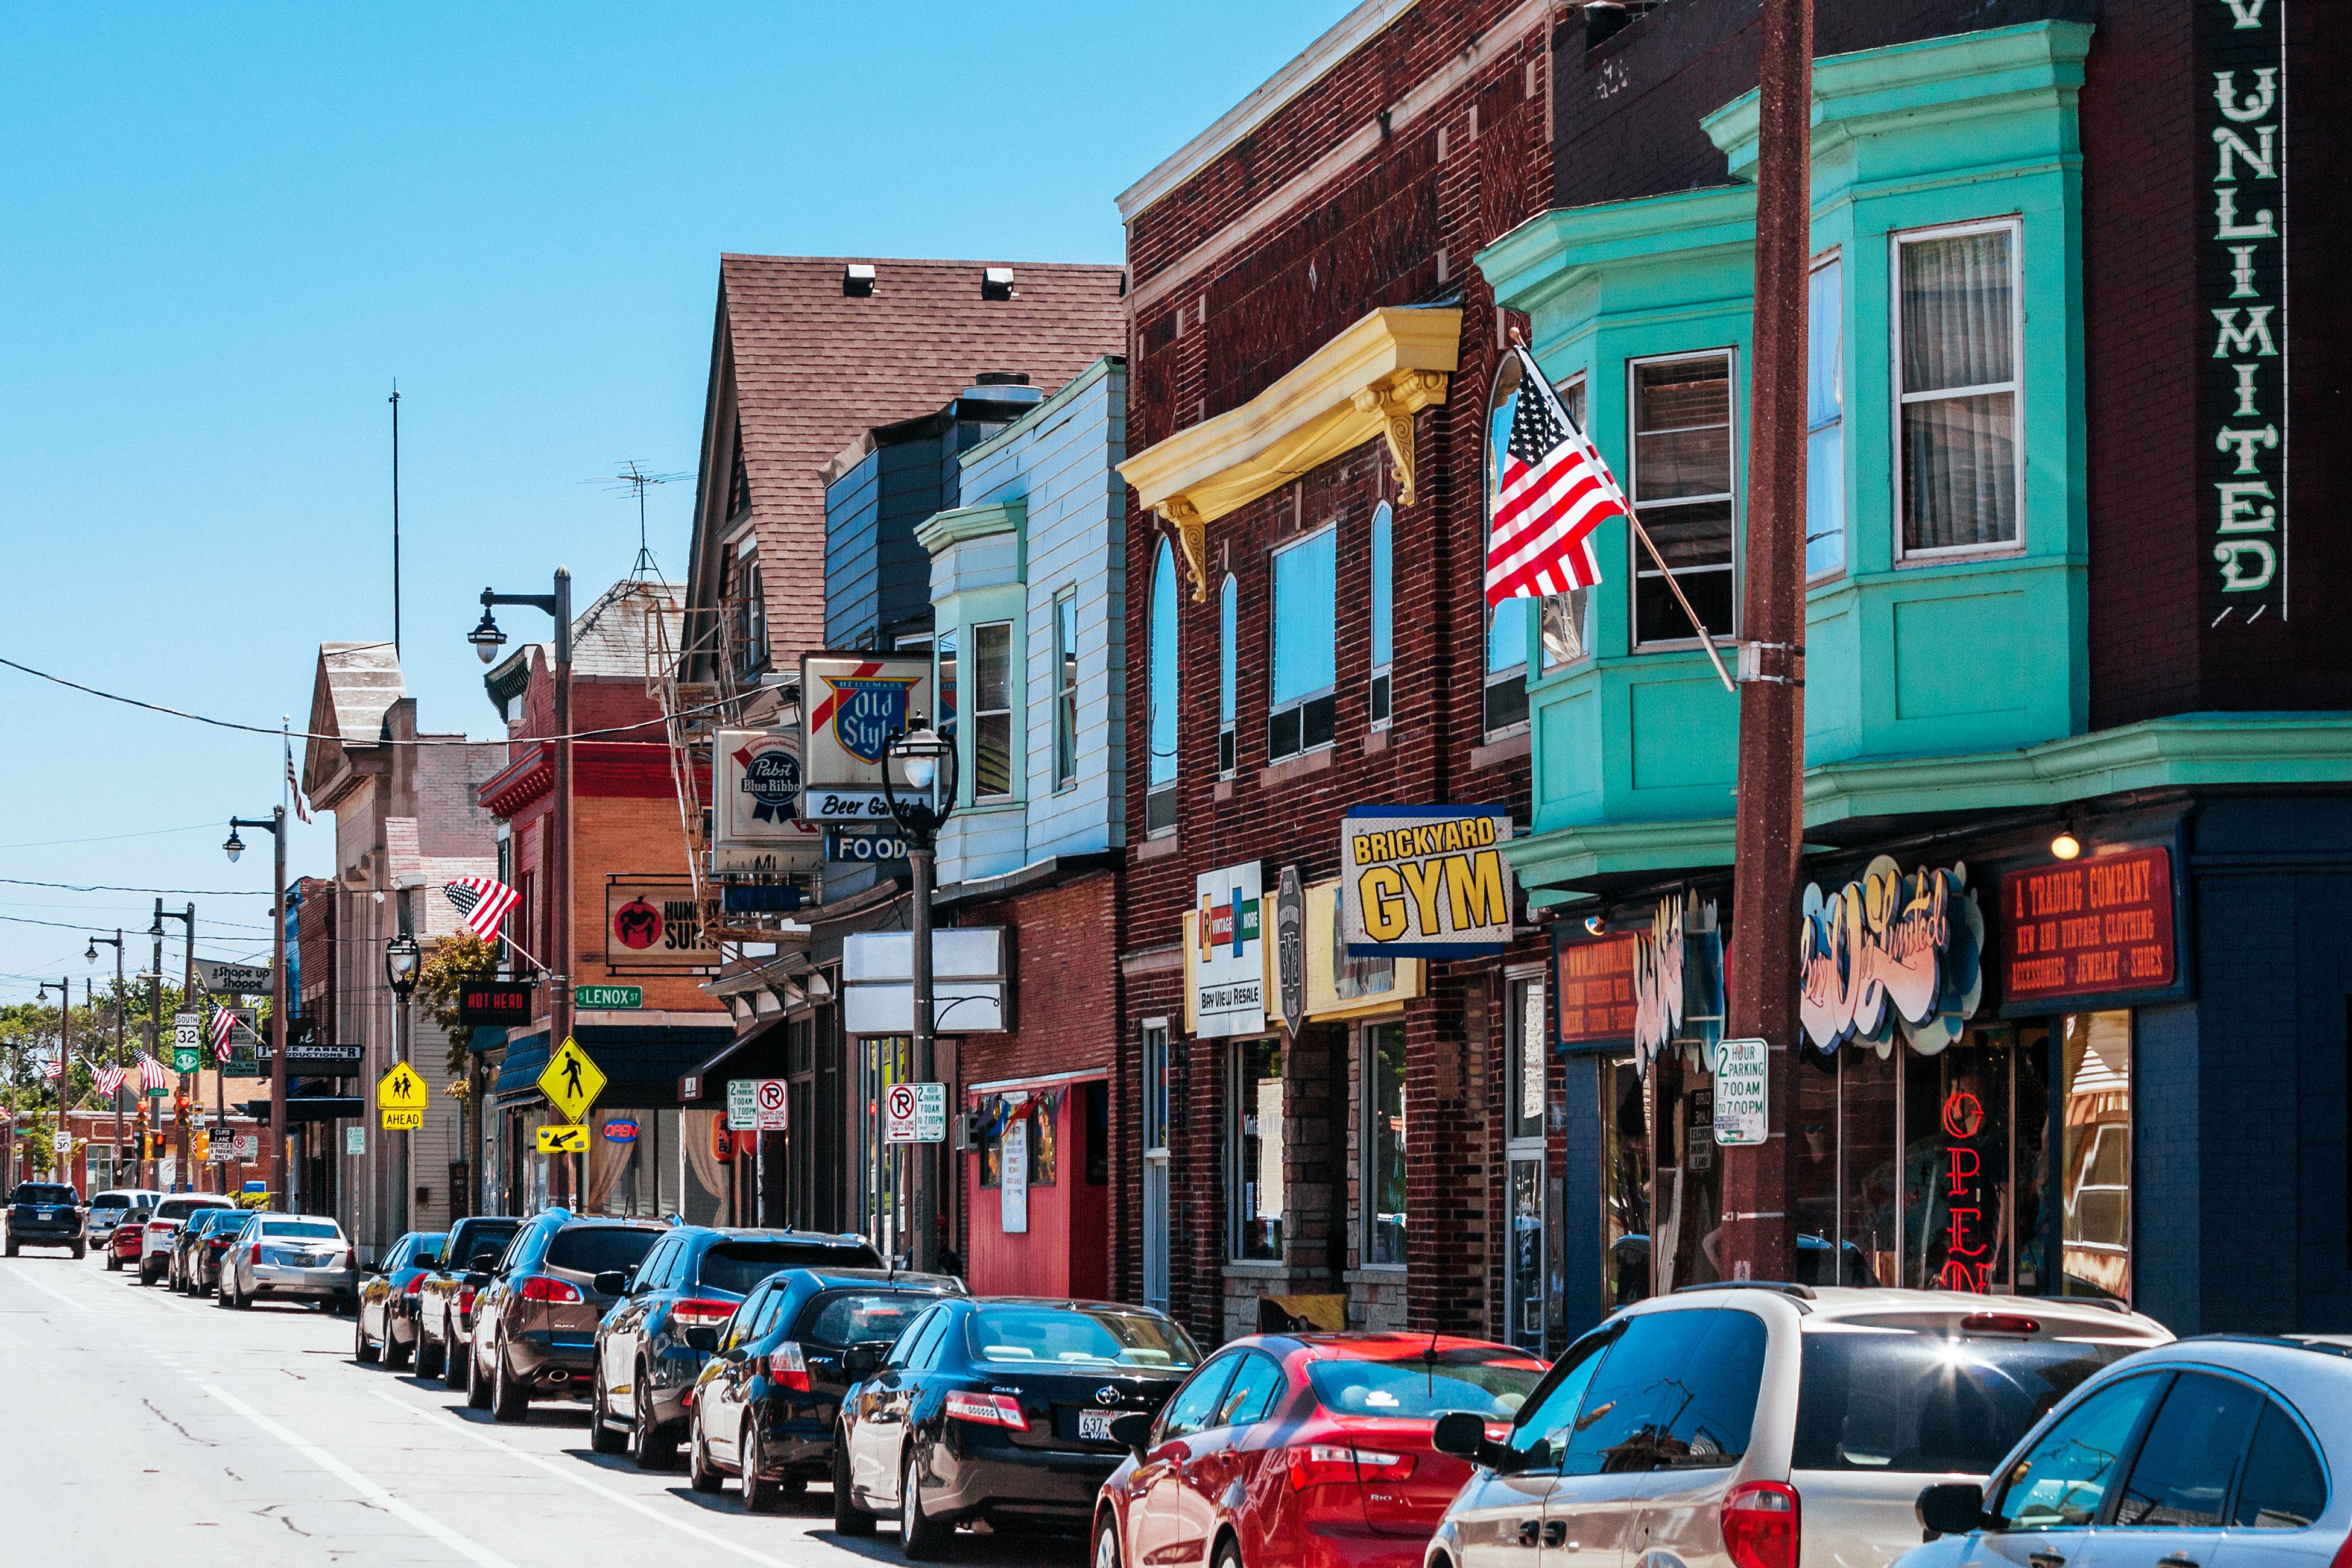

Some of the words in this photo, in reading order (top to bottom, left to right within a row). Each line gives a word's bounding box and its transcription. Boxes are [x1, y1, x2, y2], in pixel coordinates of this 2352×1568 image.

[2212, 68, 2278, 592] UNLIMITED
[855, 692, 892, 718] Old
[844, 716, 896, 754] Styl
[755, 759, 792, 776] Pabst
[744, 779, 767, 792] Blue
[769, 779, 800, 792] Ribbo
[821, 795, 864, 815] Beer
[839, 838, 906, 859] FOOD
[1353, 817, 1496, 865] BRICKYARD
[1358, 849, 1508, 943] GYM
[2016, 879, 2023, 918] A
[2029, 870, 2082, 916] TRADING
[2090, 859, 2150, 908] COMPANY
[1212, 916, 1233, 935] VINTAGE
[1244, 911, 1258, 929] MORE
[2017, 925, 2035, 955] NEW
[2040, 922, 2056, 952] AND
[2061, 915, 2100, 949] VINTAGE
[2105, 909, 2154, 944] CLOTHING
[219, 966, 252, 979] Shape
[256, 970, 270, 981] up
[2012, 956, 2065, 990] ACCESSORIES
[2076, 950, 2119, 984] JEWELRY
[2131, 944, 2163, 978] SHOES
[223, 978, 263, 988] Shoppe
[469, 993, 488, 1008] HOT
[494, 993, 522, 1008] HEAD
[586, 990, 628, 1004] LENOX
[179, 1030, 196, 1043] 32
[306, 1046, 356, 1057] PARKER
[1719, 1047, 1728, 1078] 2
[1732, 1046, 1755, 1061] HOUR
[1728, 1062, 1763, 1077] PARKING
[731, 1083, 736, 1095] 2
[918, 1087, 923, 1101] 2
[387, 1114, 419, 1124] AHEAD
[604, 1124, 638, 1137] OPEN
[1941, 1092, 1993, 1294] OPEN
